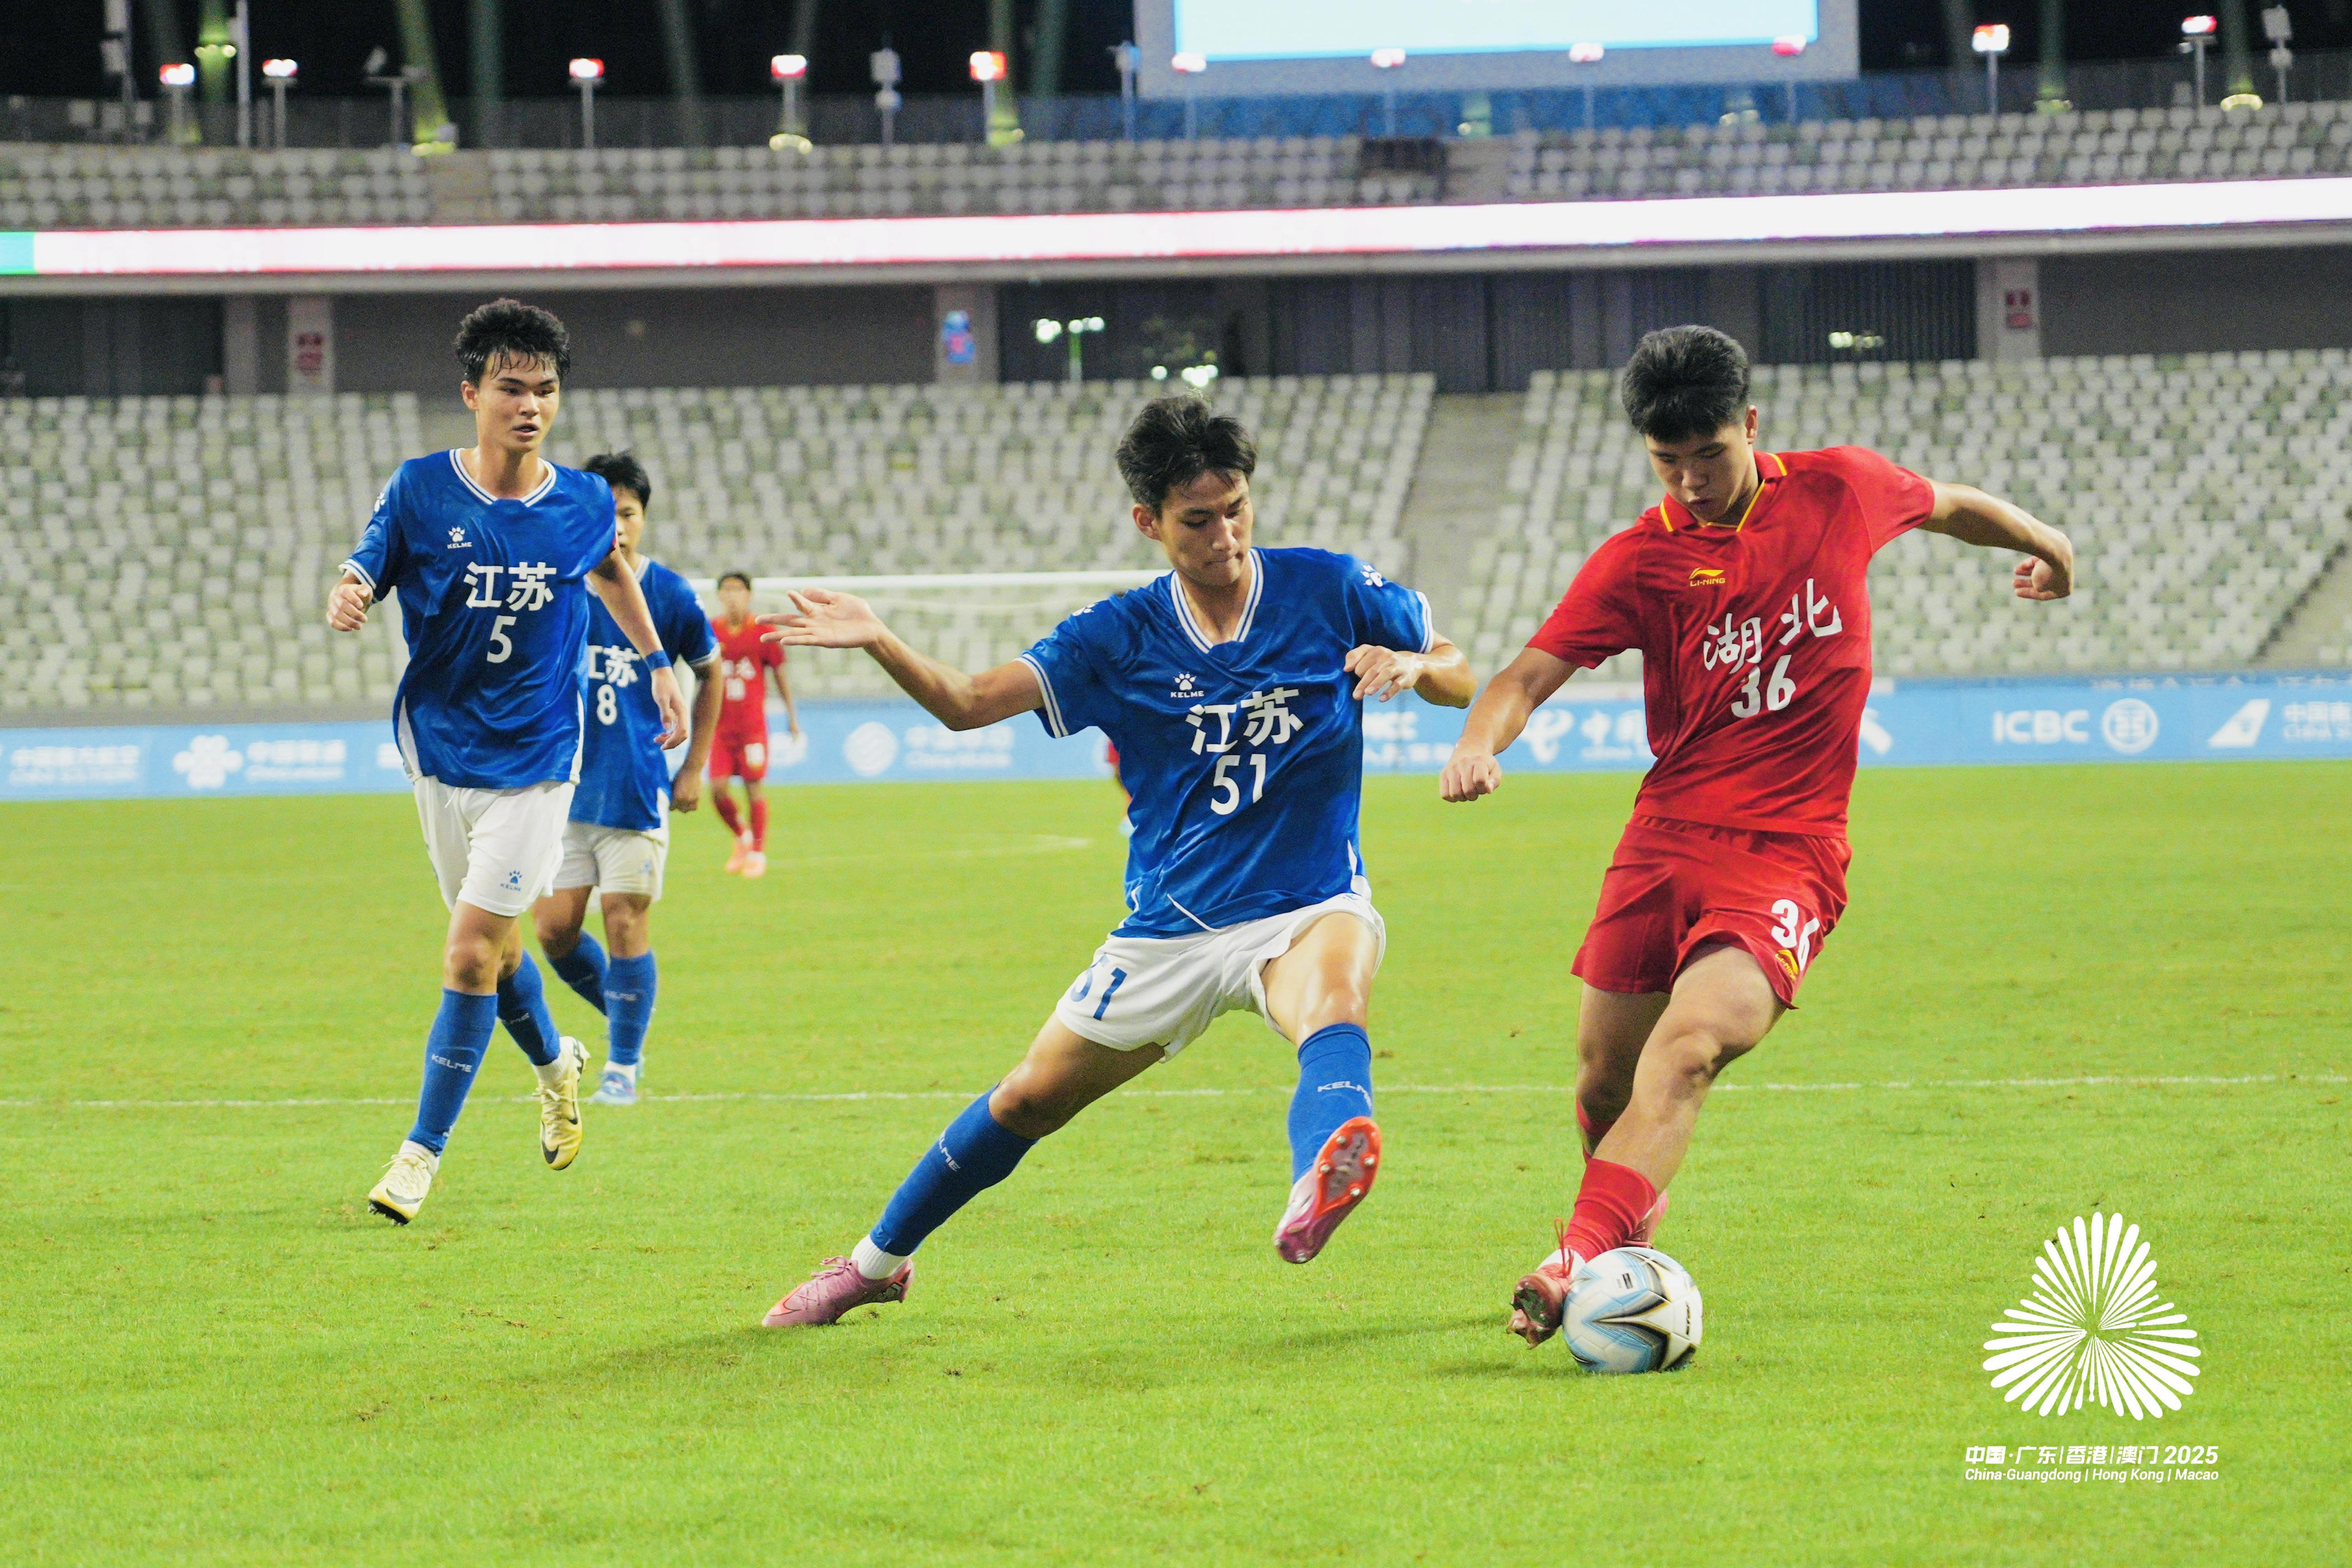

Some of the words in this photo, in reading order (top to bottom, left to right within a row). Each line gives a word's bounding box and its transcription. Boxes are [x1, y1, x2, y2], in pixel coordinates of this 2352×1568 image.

[464, 561, 557, 612] 江苏
[1690, 578, 1726, 587] LI-NING
[487, 615, 517, 663] 5
[1703, 578, 1843, 674] 湖北
[597, 684, 617, 726] 8
[1731, 654, 1796, 718] 36
[1185, 687, 1304, 755] 江苏
[1993, 710, 2089, 743] ICBC
[1211, 753, 1266, 815] 51
[432, 1054, 473, 1073] KELME
